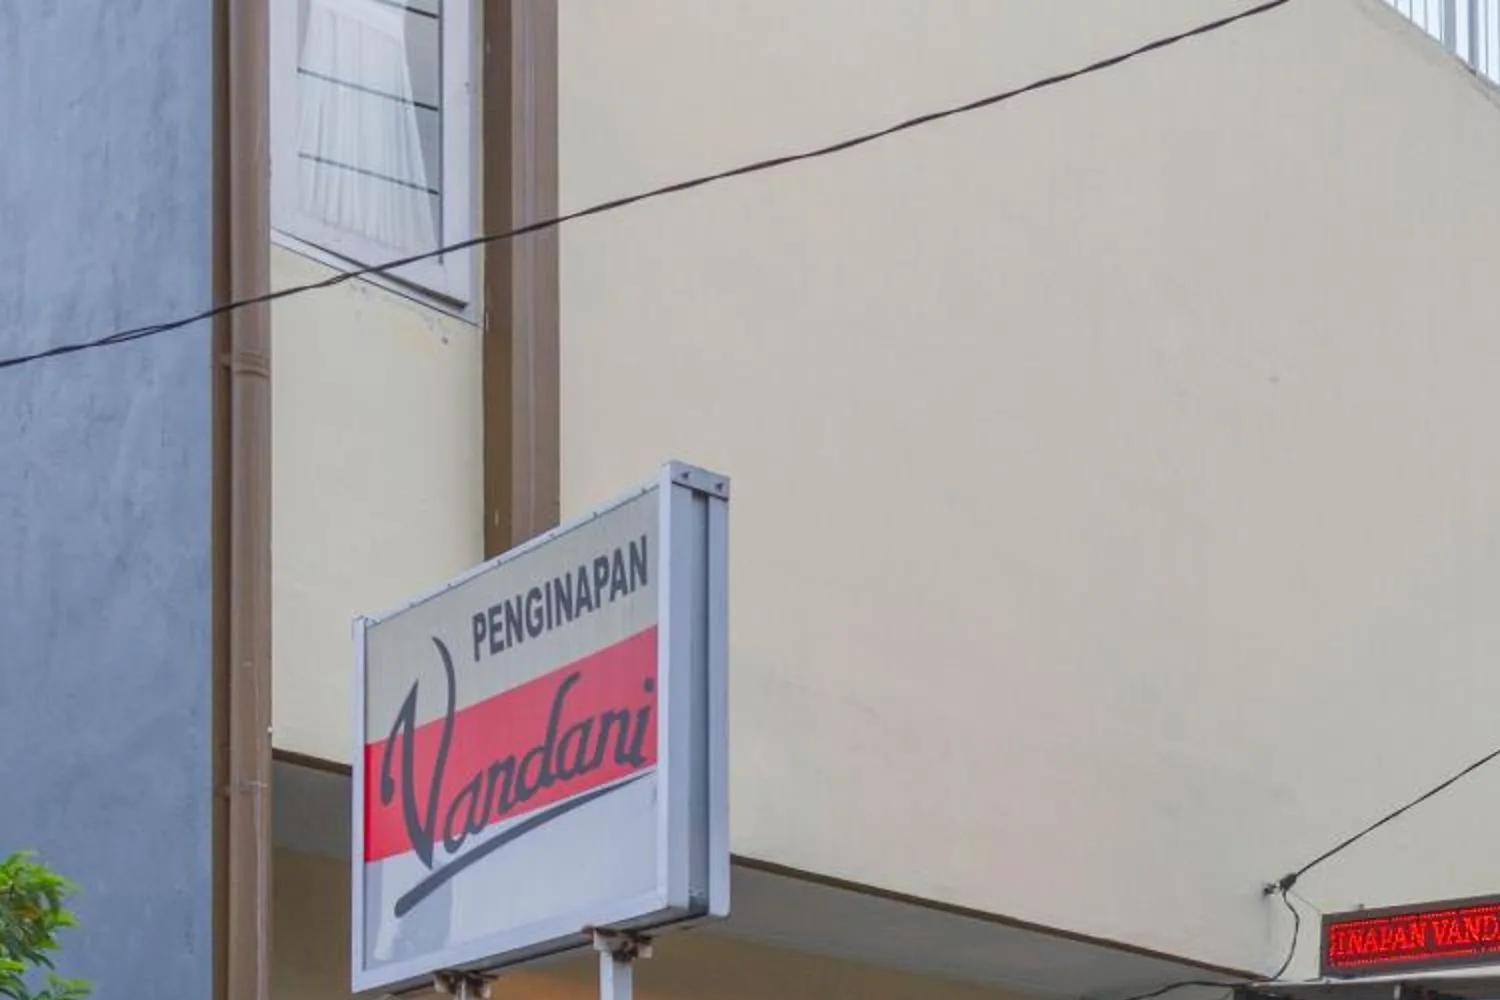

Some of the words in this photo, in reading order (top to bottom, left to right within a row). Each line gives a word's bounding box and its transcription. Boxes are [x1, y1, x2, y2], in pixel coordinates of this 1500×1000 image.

[471, 534, 648, 662] PENGINAPAN
[381, 636, 655, 870] Vandani
[1331, 921, 1427, 955] INAPAN
